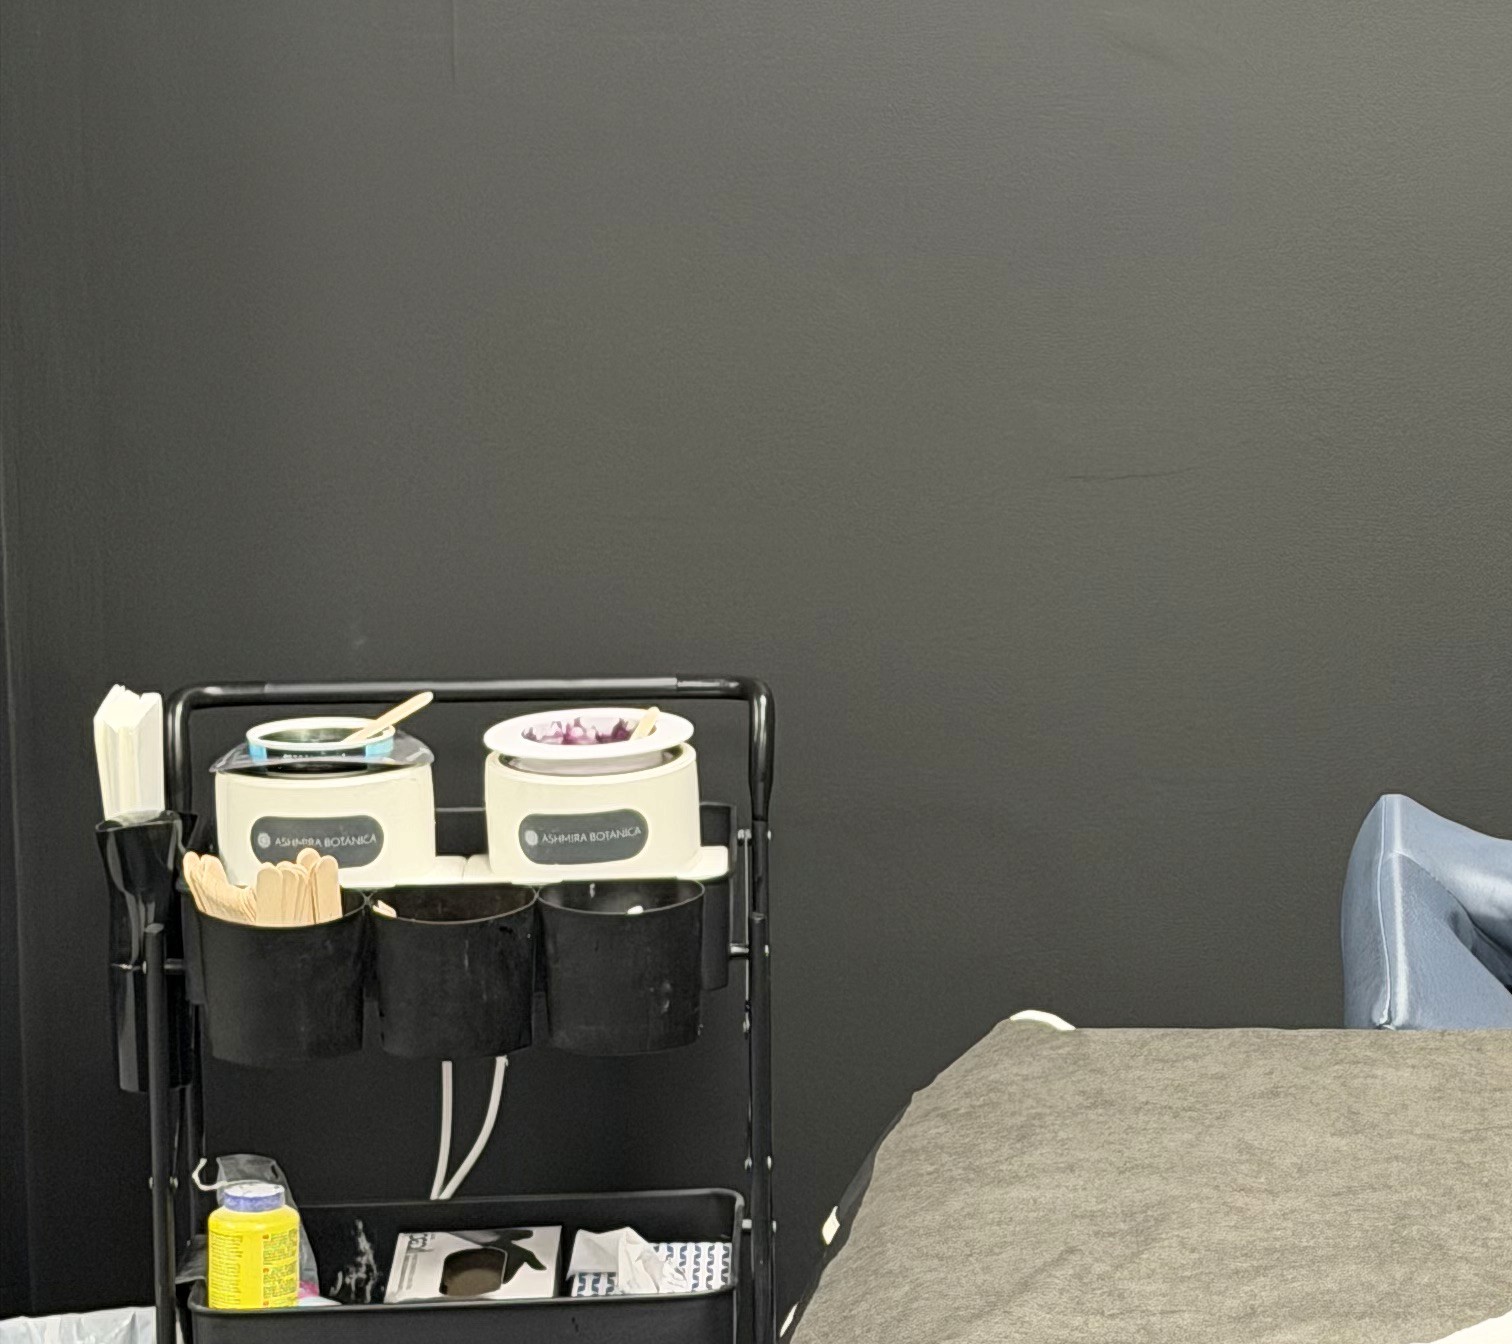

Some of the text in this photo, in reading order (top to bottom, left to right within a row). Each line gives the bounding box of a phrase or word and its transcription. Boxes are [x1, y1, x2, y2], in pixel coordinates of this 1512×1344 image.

[324, 833, 377, 848] BOTANICA
[541, 826, 641, 844] ASHMIRA BOTANICA
